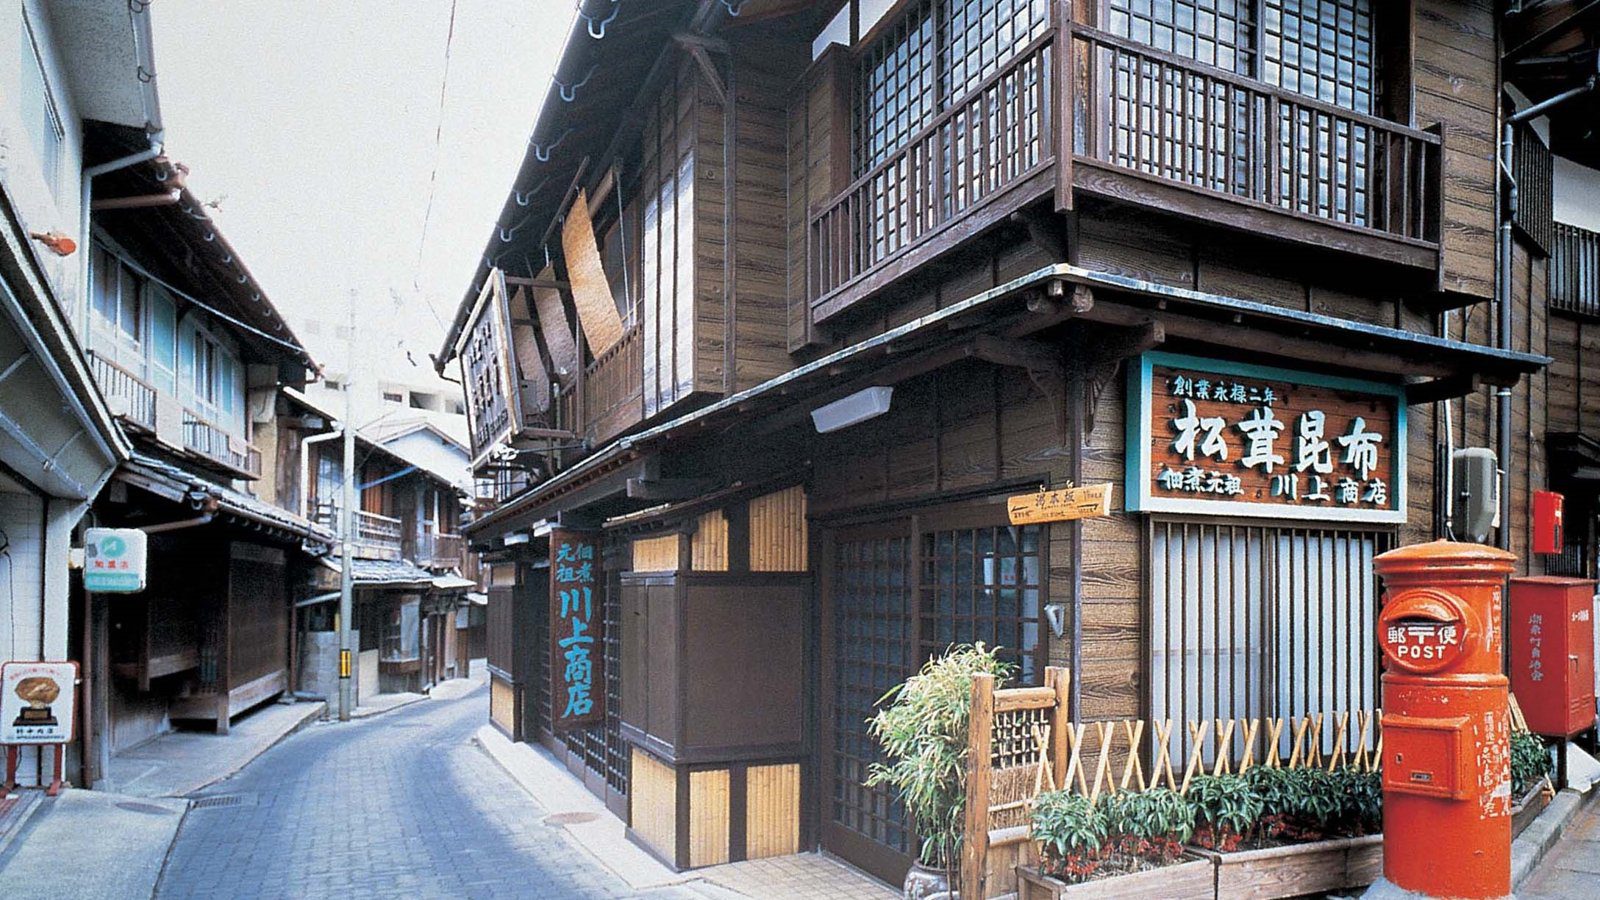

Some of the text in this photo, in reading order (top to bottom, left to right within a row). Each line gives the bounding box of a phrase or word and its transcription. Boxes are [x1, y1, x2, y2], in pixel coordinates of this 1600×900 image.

[1174, 399, 1382, 481] 松茸昆布
[1165, 467, 1387, 505] 佃煮元祖 川上商店
[558, 587, 594, 718] 川上商店
[1398, 645, 1446, 659] POST
